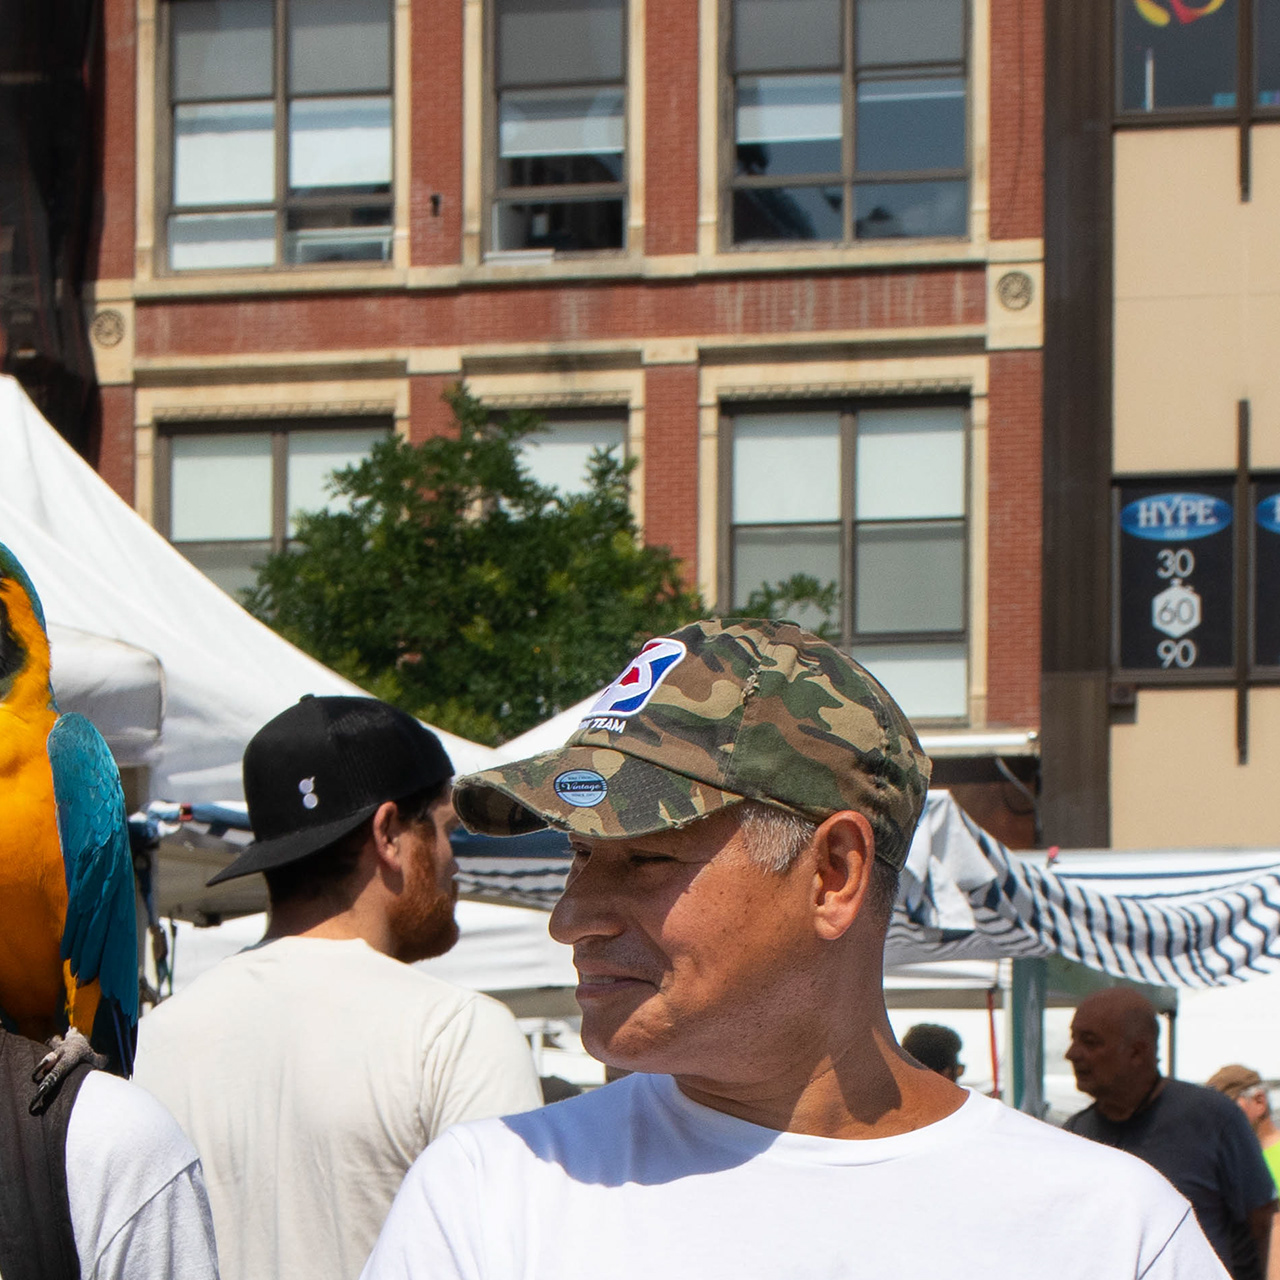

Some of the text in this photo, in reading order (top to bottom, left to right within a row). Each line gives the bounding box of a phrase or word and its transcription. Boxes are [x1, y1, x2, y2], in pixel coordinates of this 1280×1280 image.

[1138, 496, 1220, 528] HYPE
[1156, 548, 1196, 579] 30
[1158, 596, 1196, 626] 60
[1156, 638, 1197, 669] 90
[589, 717, 627, 734] TEAM
[561, 782, 601, 792] Vintage
